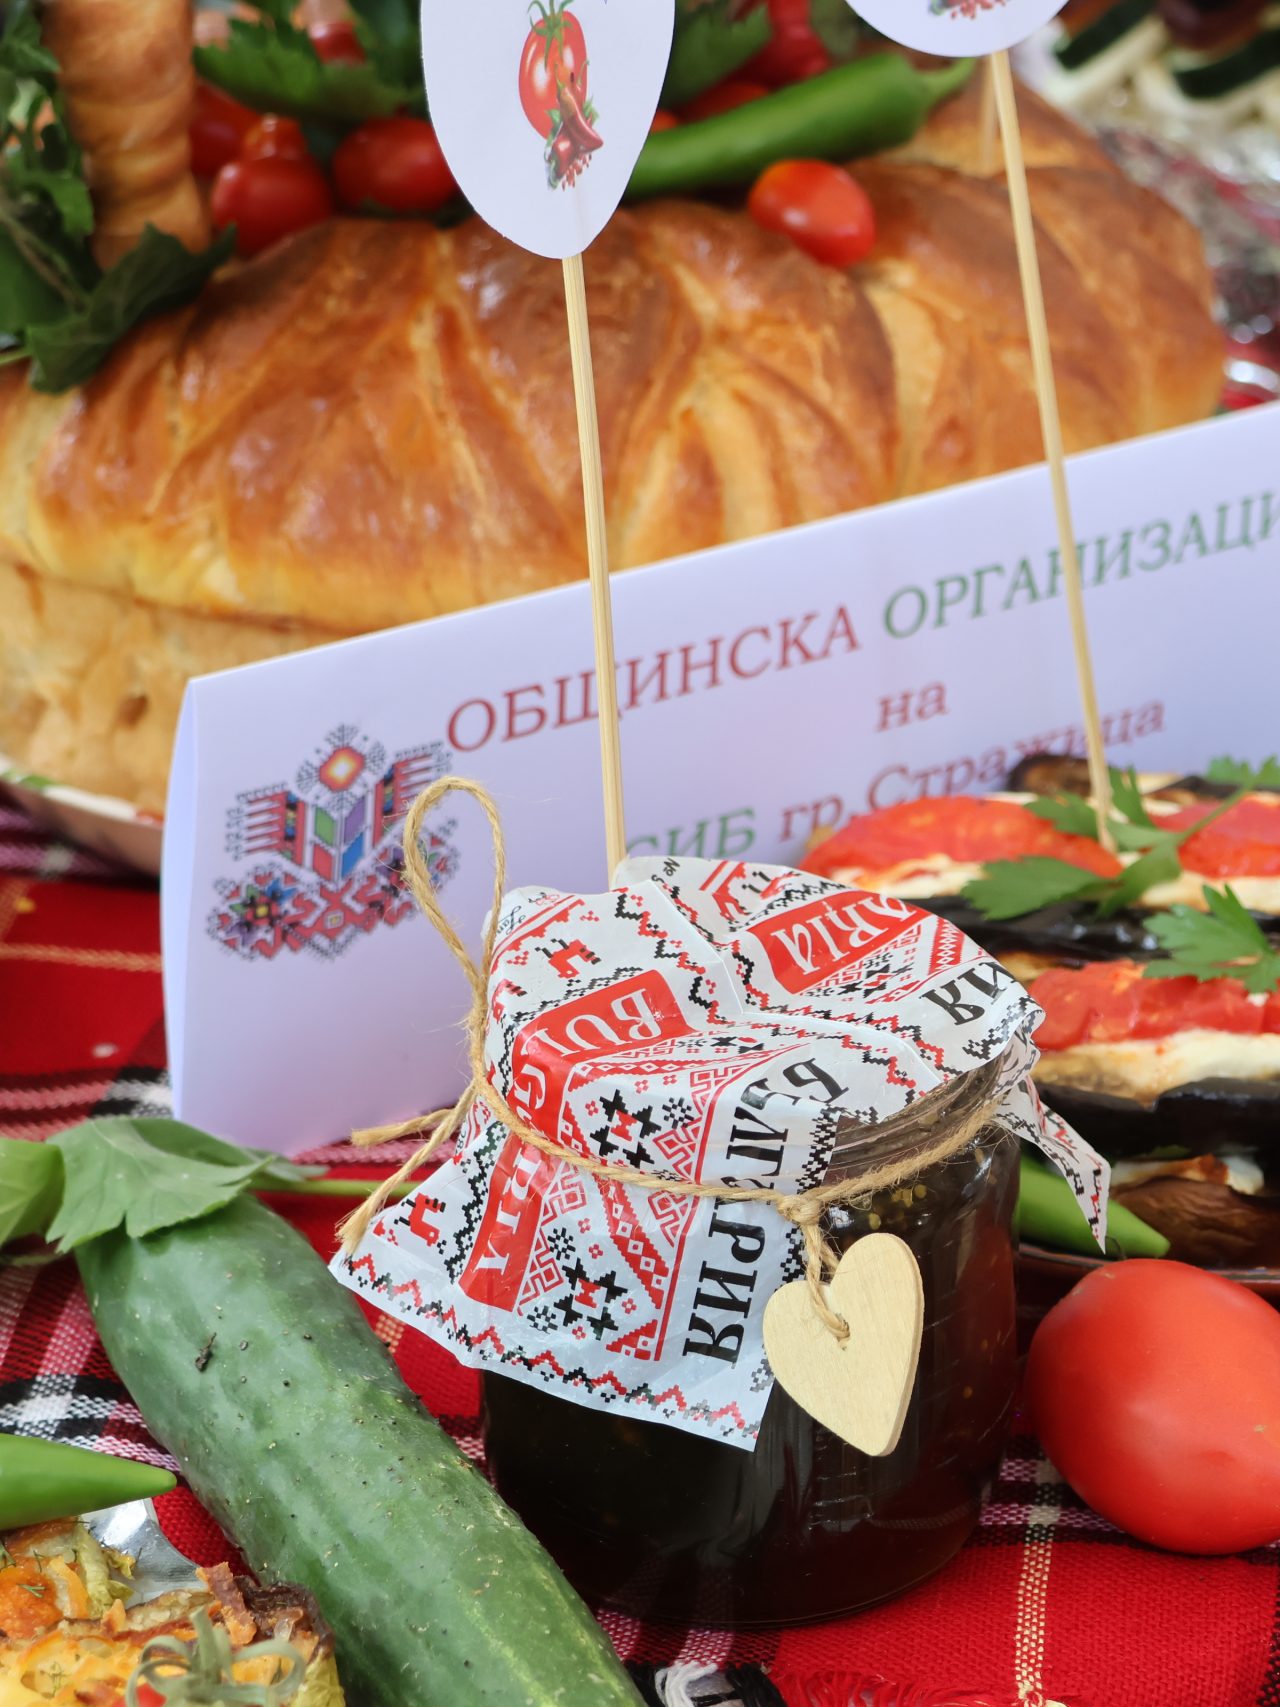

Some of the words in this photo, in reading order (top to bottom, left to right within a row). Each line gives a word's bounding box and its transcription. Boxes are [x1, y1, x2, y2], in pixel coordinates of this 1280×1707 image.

[446, 602, 862, 753] ОБЩИНСКА
[875, 680, 949, 733] на
[477, 987, 662, 1277] BULGRIA
